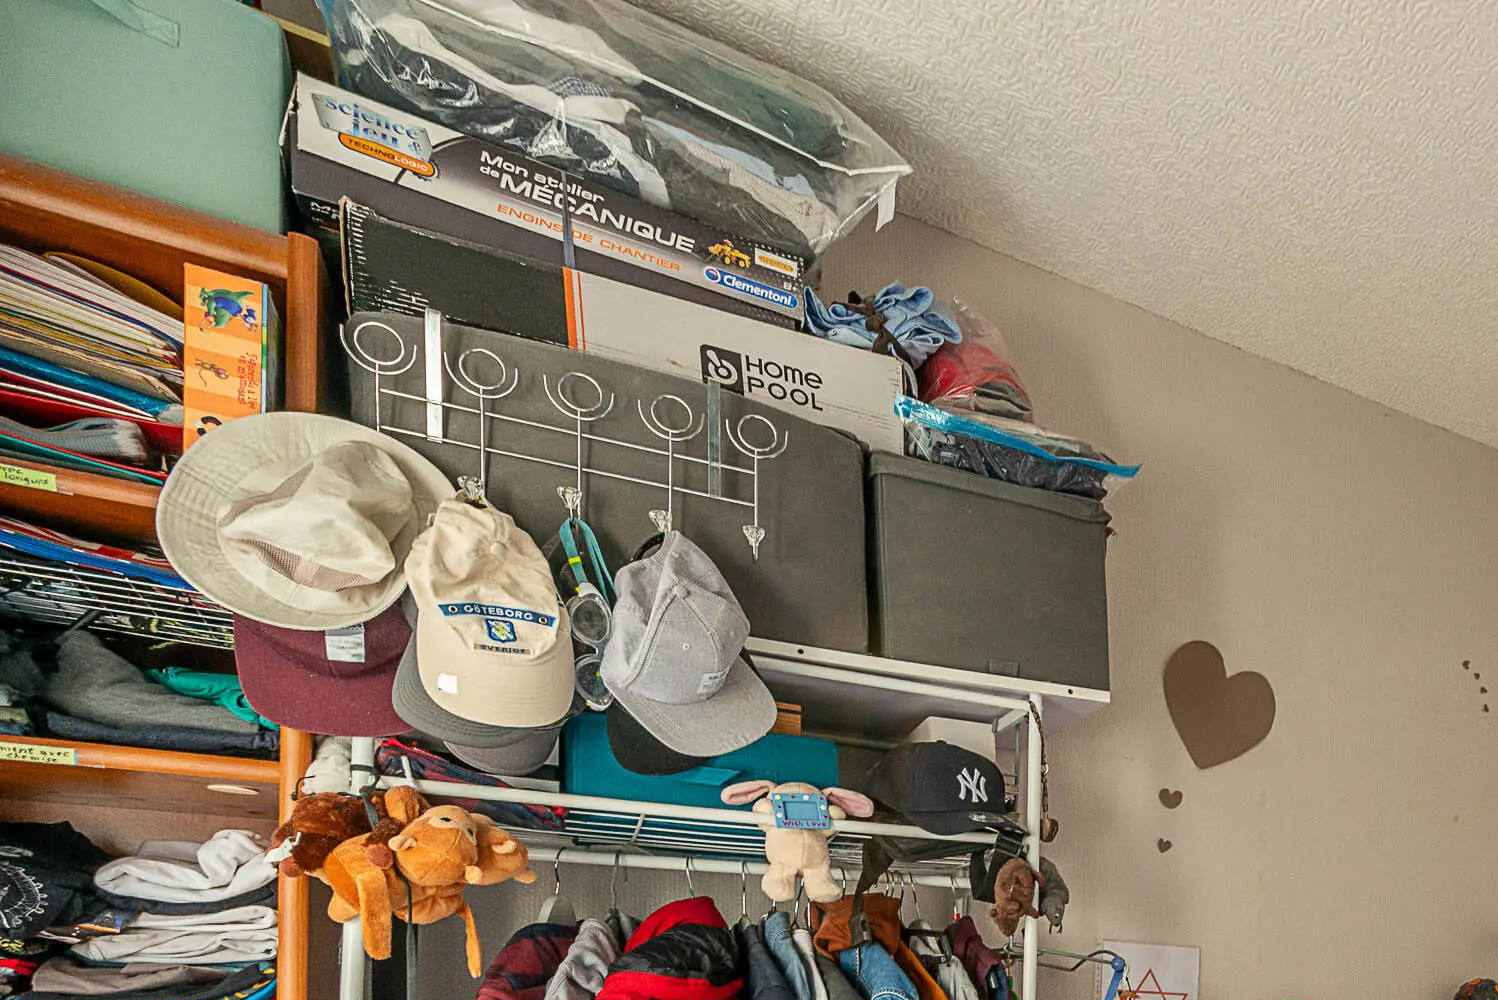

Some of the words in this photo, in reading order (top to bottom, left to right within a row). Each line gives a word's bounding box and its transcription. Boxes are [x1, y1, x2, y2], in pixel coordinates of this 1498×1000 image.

[324, 96, 418, 140] science
[347, 138, 429, 173] TECHNOLOGIC
[480, 151, 528, 178] Mon
[533, 173, 605, 202] atelier
[479, 164, 500, 179] de
[499, 175, 696, 254] MÉCANIQUE
[497, 204, 564, 232] ENGINS
[571, 231, 593, 243] DE
[599, 239, 681, 272] CHANTIER
[723, 274, 793, 306] Clementoni
[747, 376, 823, 411] POOL
[463, 604, 534, 621] GÖTEBORG
[956, 767, 988, 802] NY
